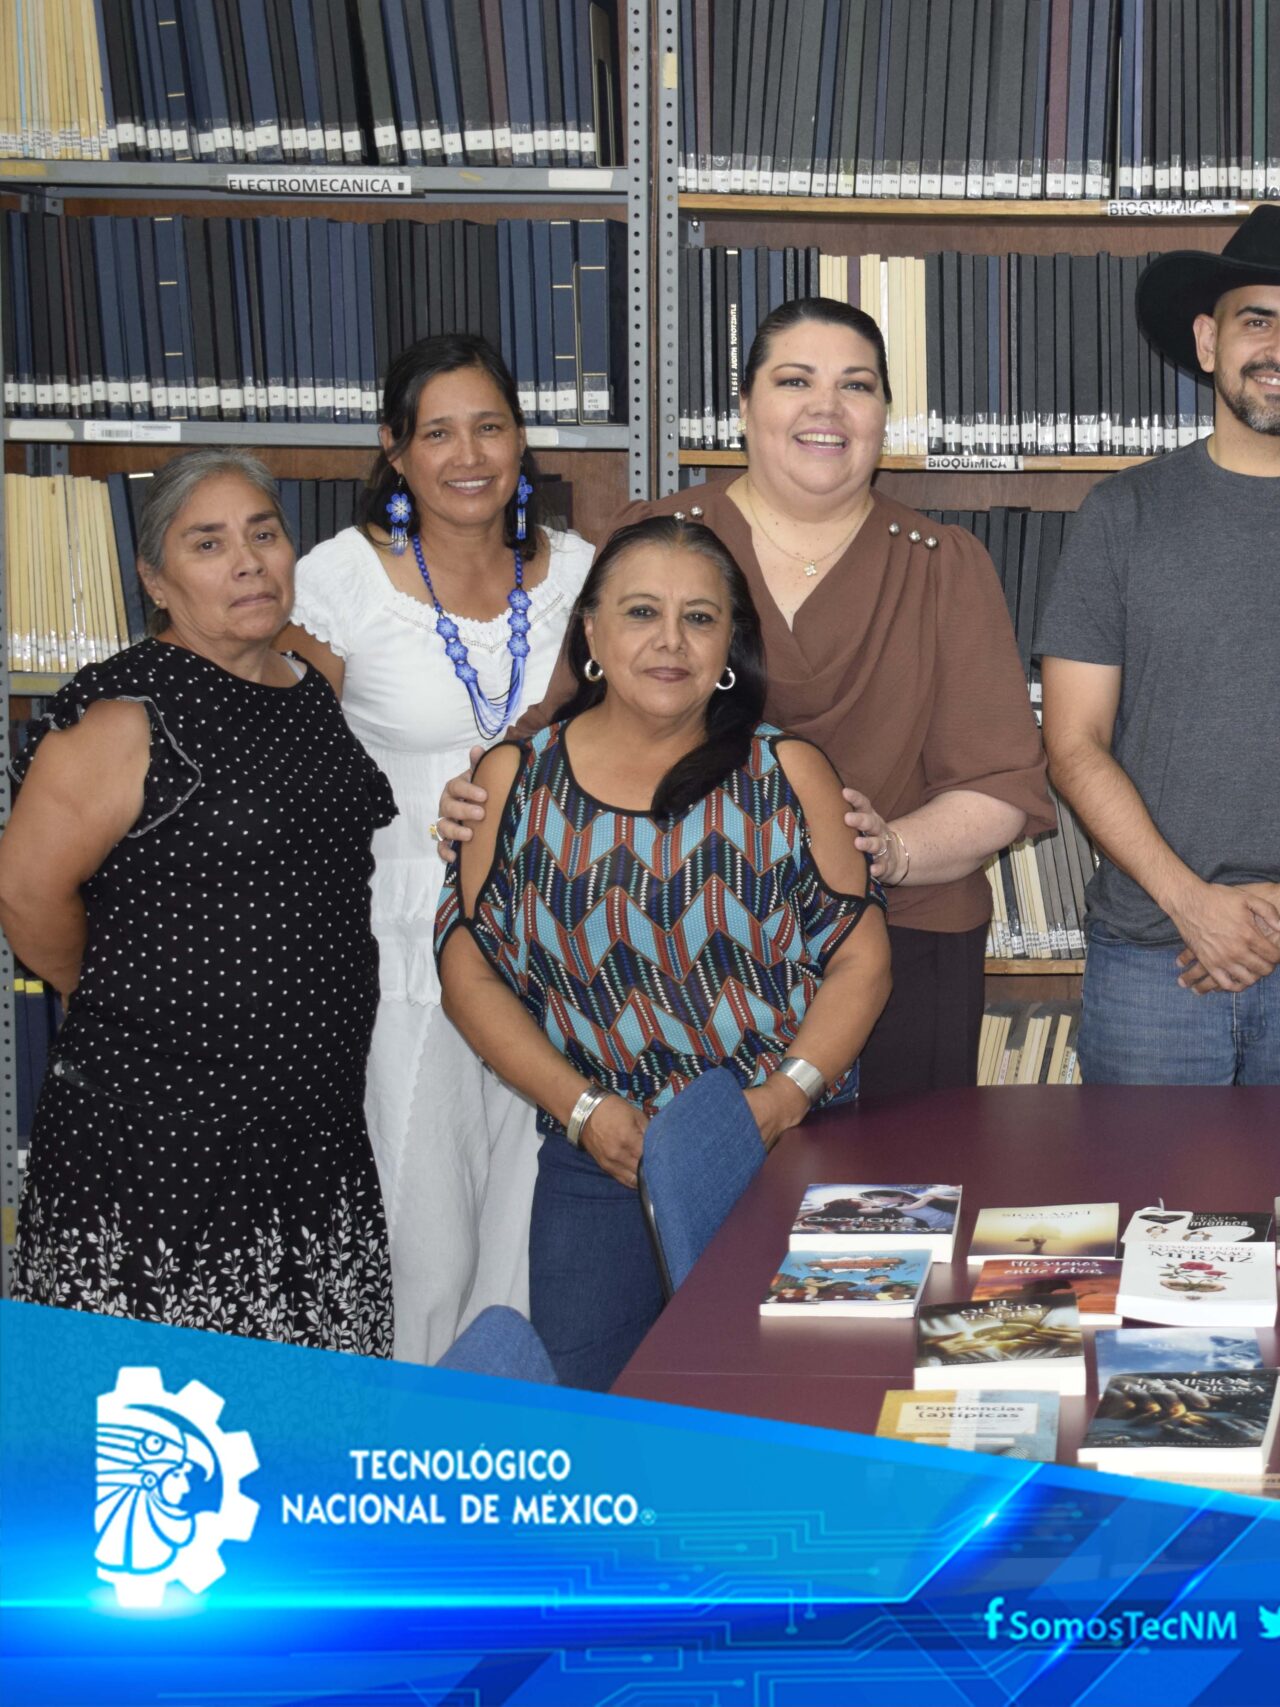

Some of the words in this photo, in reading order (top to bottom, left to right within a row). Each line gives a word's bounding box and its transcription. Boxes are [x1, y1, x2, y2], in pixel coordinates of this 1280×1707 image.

[228, 178, 393, 193] ELECTROMECANICA
[927, 456, 1007, 470] BIOQUIMICA
[914, 1405, 1025, 1413] Experiencias
